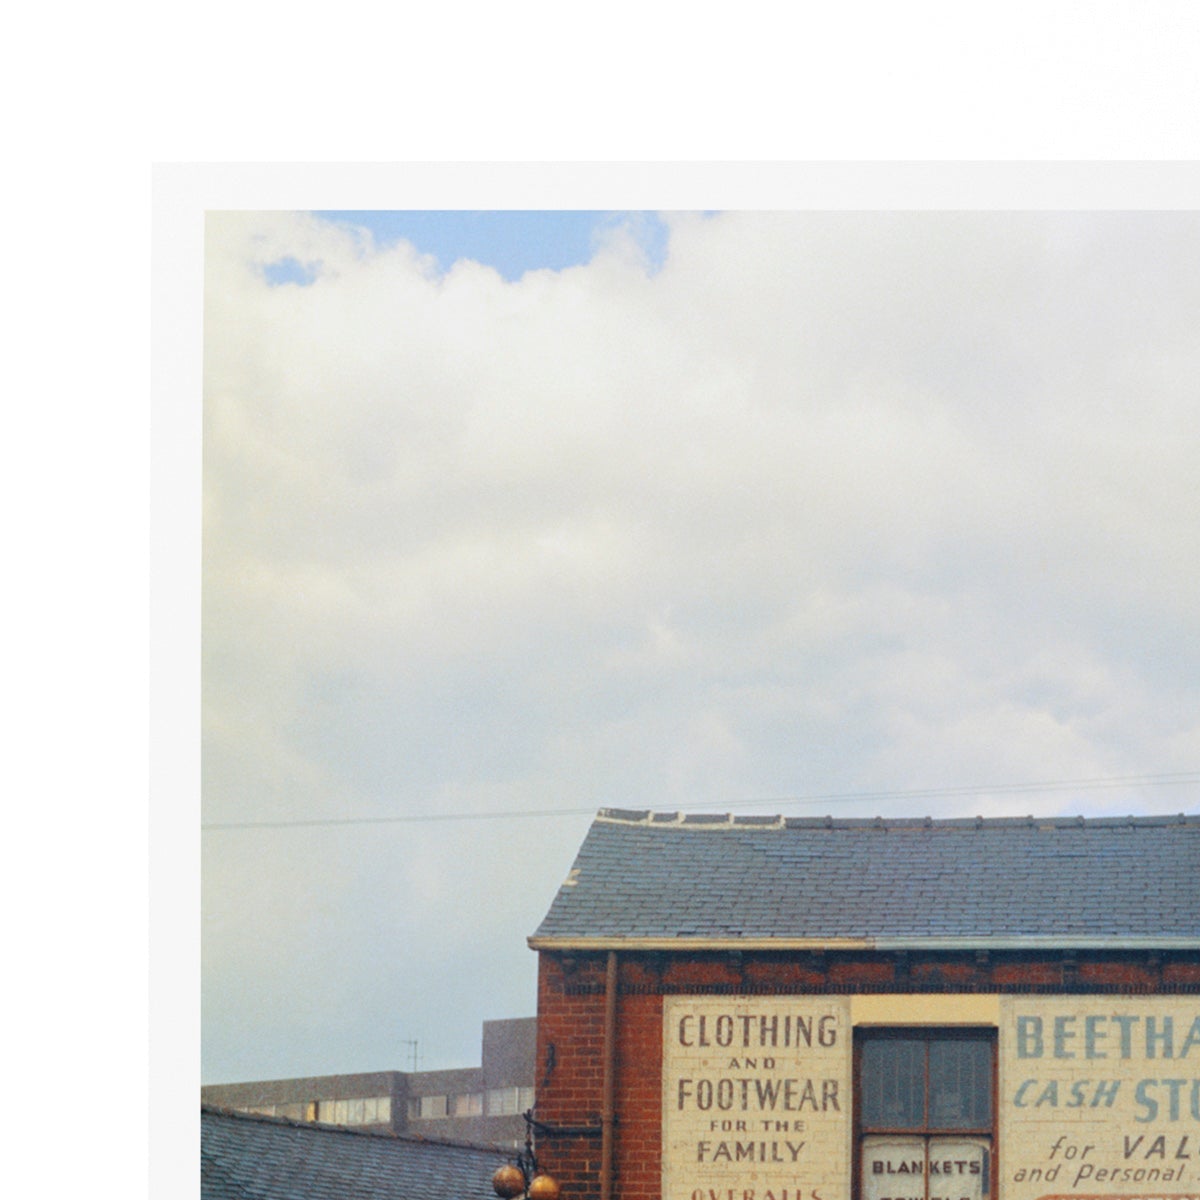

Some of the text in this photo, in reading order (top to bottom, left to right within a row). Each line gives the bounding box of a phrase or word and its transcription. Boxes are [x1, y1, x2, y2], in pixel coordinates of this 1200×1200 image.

[679, 1015, 837, 1048] CLOTHING
[729, 1057, 776, 1070] AND
[678, 1079, 840, 1112] FOOTWEAR
[1013, 1079, 1121, 1108] CASH
[711, 1120, 806, 1132] FOR THE
[697, 1141, 806, 1163] FAMILY
[1049, 1136, 1096, 1160] for
[872, 1160, 981, 1175] BLANKETS
[1014, 1164, 1062, 1183] and
